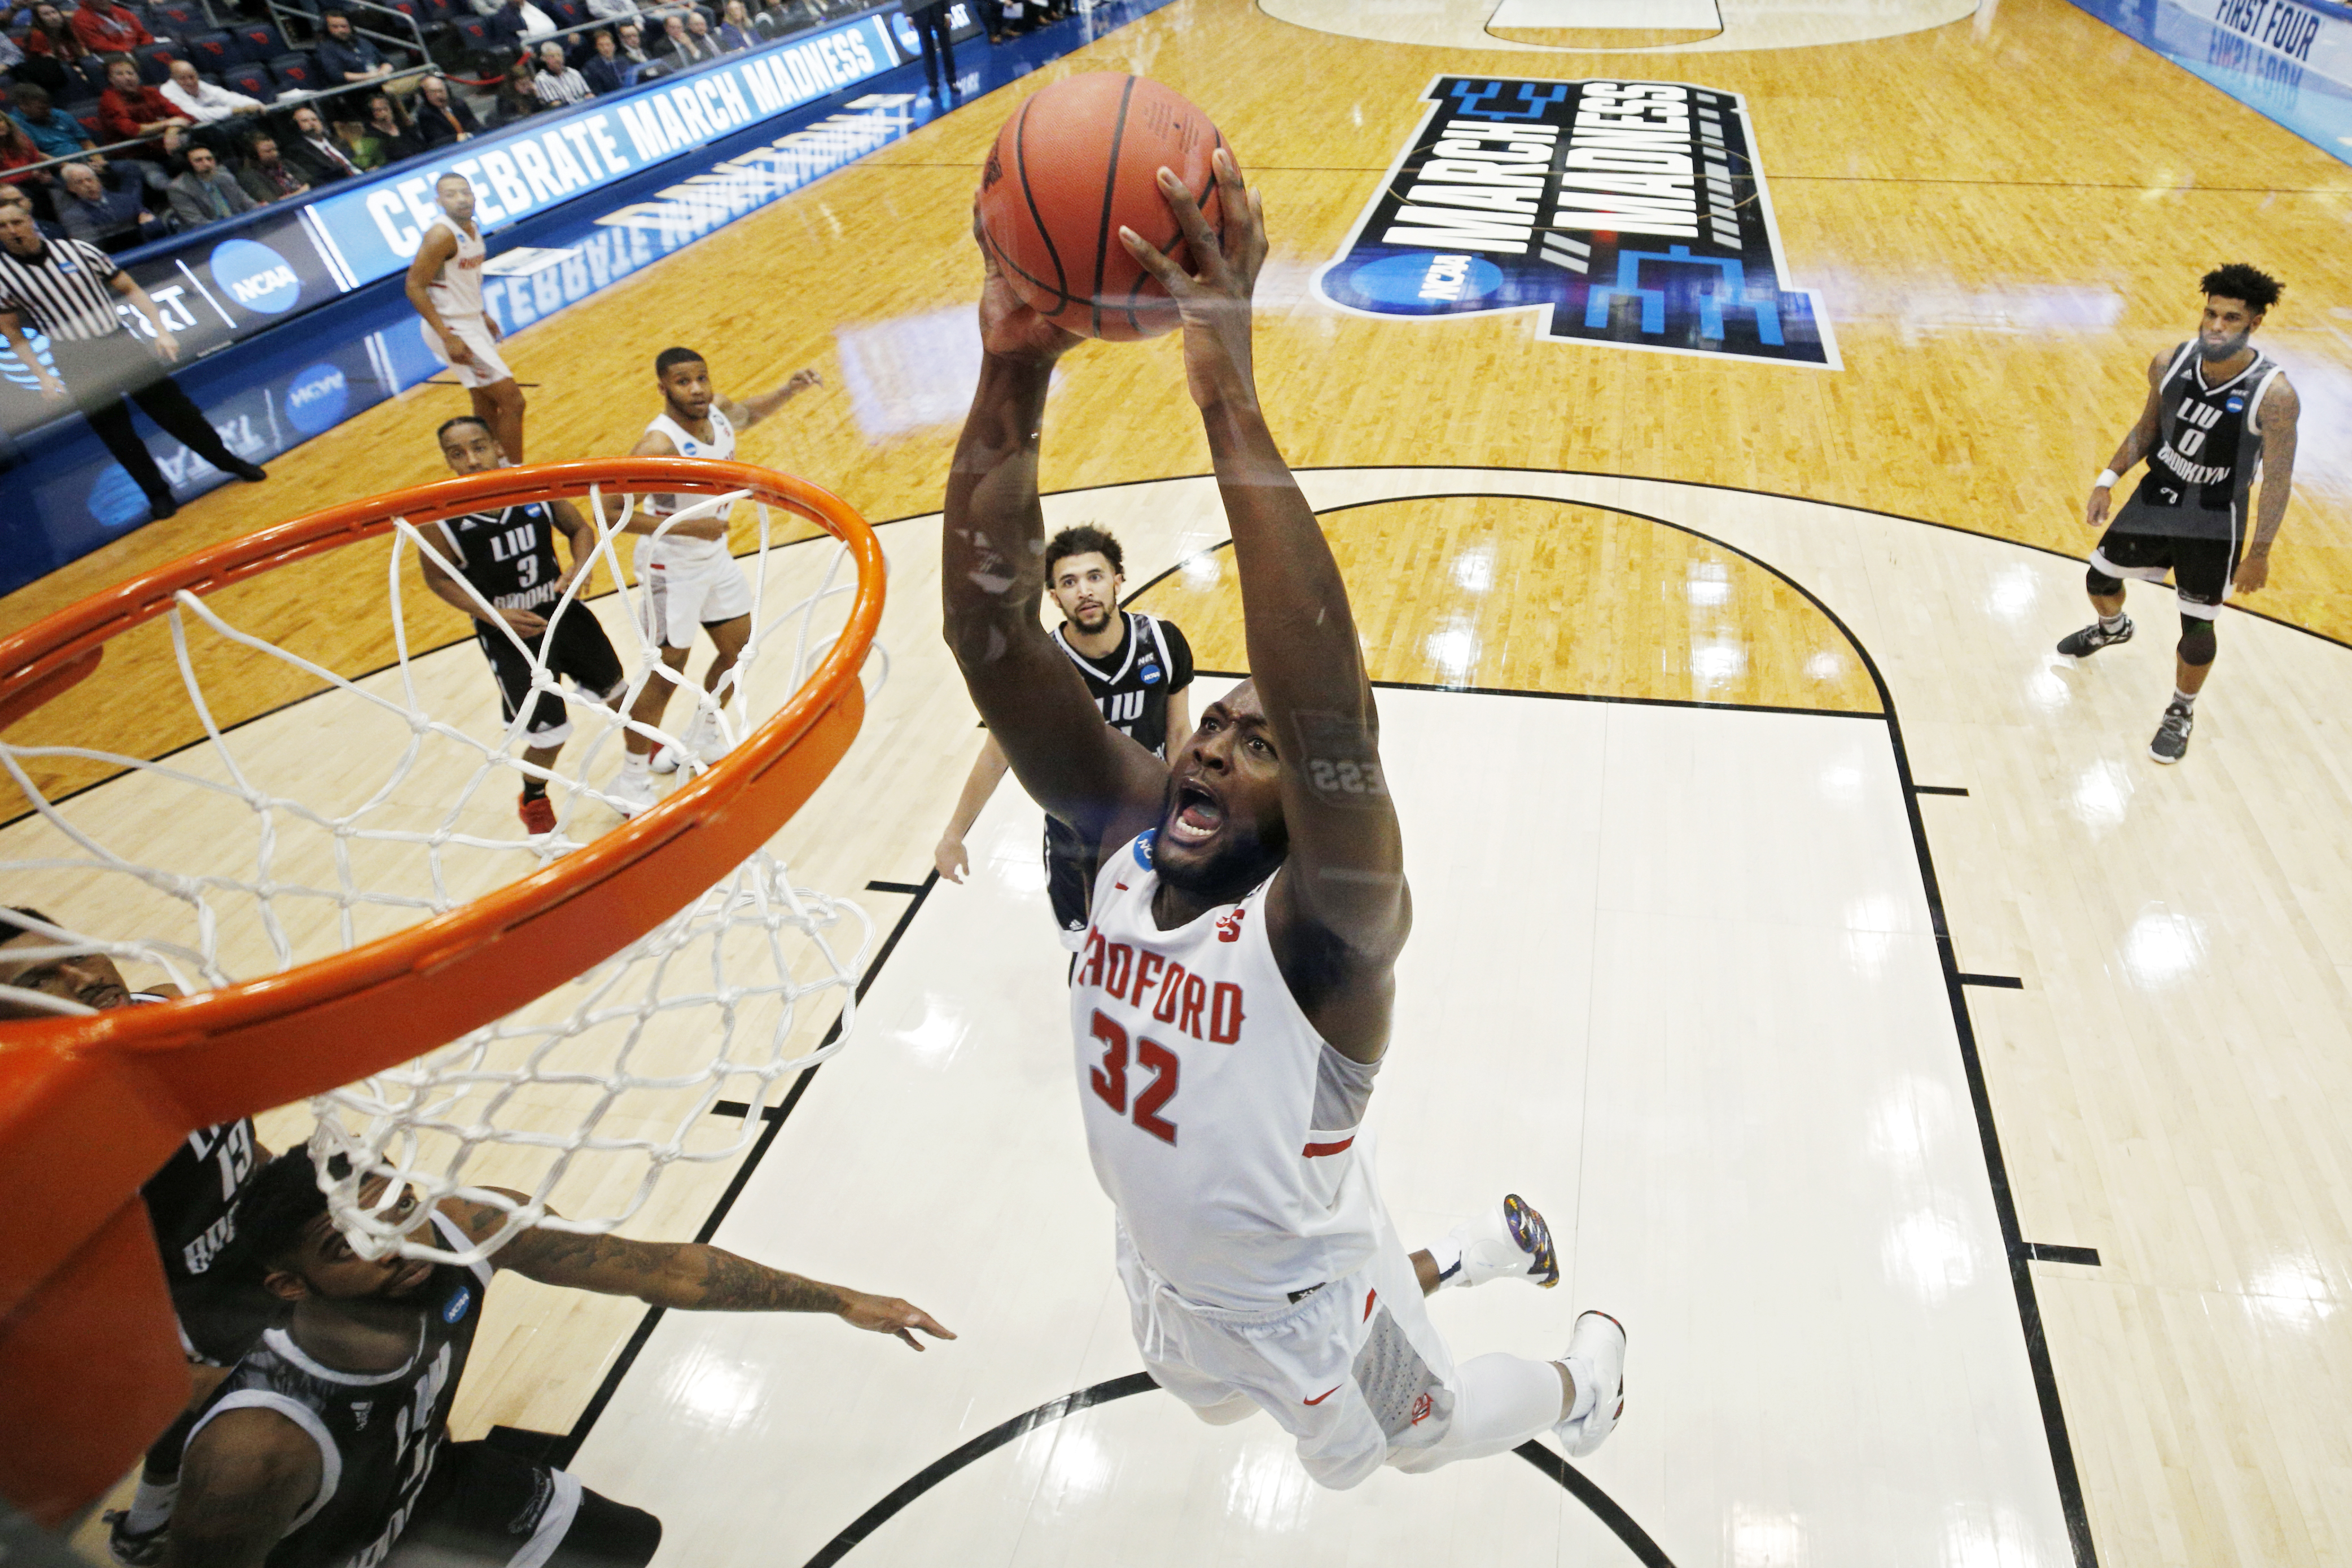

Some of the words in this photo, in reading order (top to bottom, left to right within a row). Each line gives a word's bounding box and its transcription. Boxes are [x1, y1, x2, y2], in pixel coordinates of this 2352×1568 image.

[2262, 1, 2319, 62] FOUR
[617, 71, 752, 162] MARCH
[740, 28, 876, 114] MADNESS
[1553, 82, 1699, 238] MADNESS
[1381, 120, 1560, 254] MARCH
[231, 265, 299, 303] NCAA
[1418, 255, 1472, 301] NCAA
[2176, 397, 2224, 430] LIU
[2156, 440, 2231, 486] BROOKLYN
[2178, 428, 2206, 457] 0
[489, 523, 537, 562] LIU
[516, 554, 538, 588] 3
[1078, 925, 1245, 1045] ADFORD
[1089, 1007, 1180, 1147] 32
[216, 1117, 252, 1202] 13
